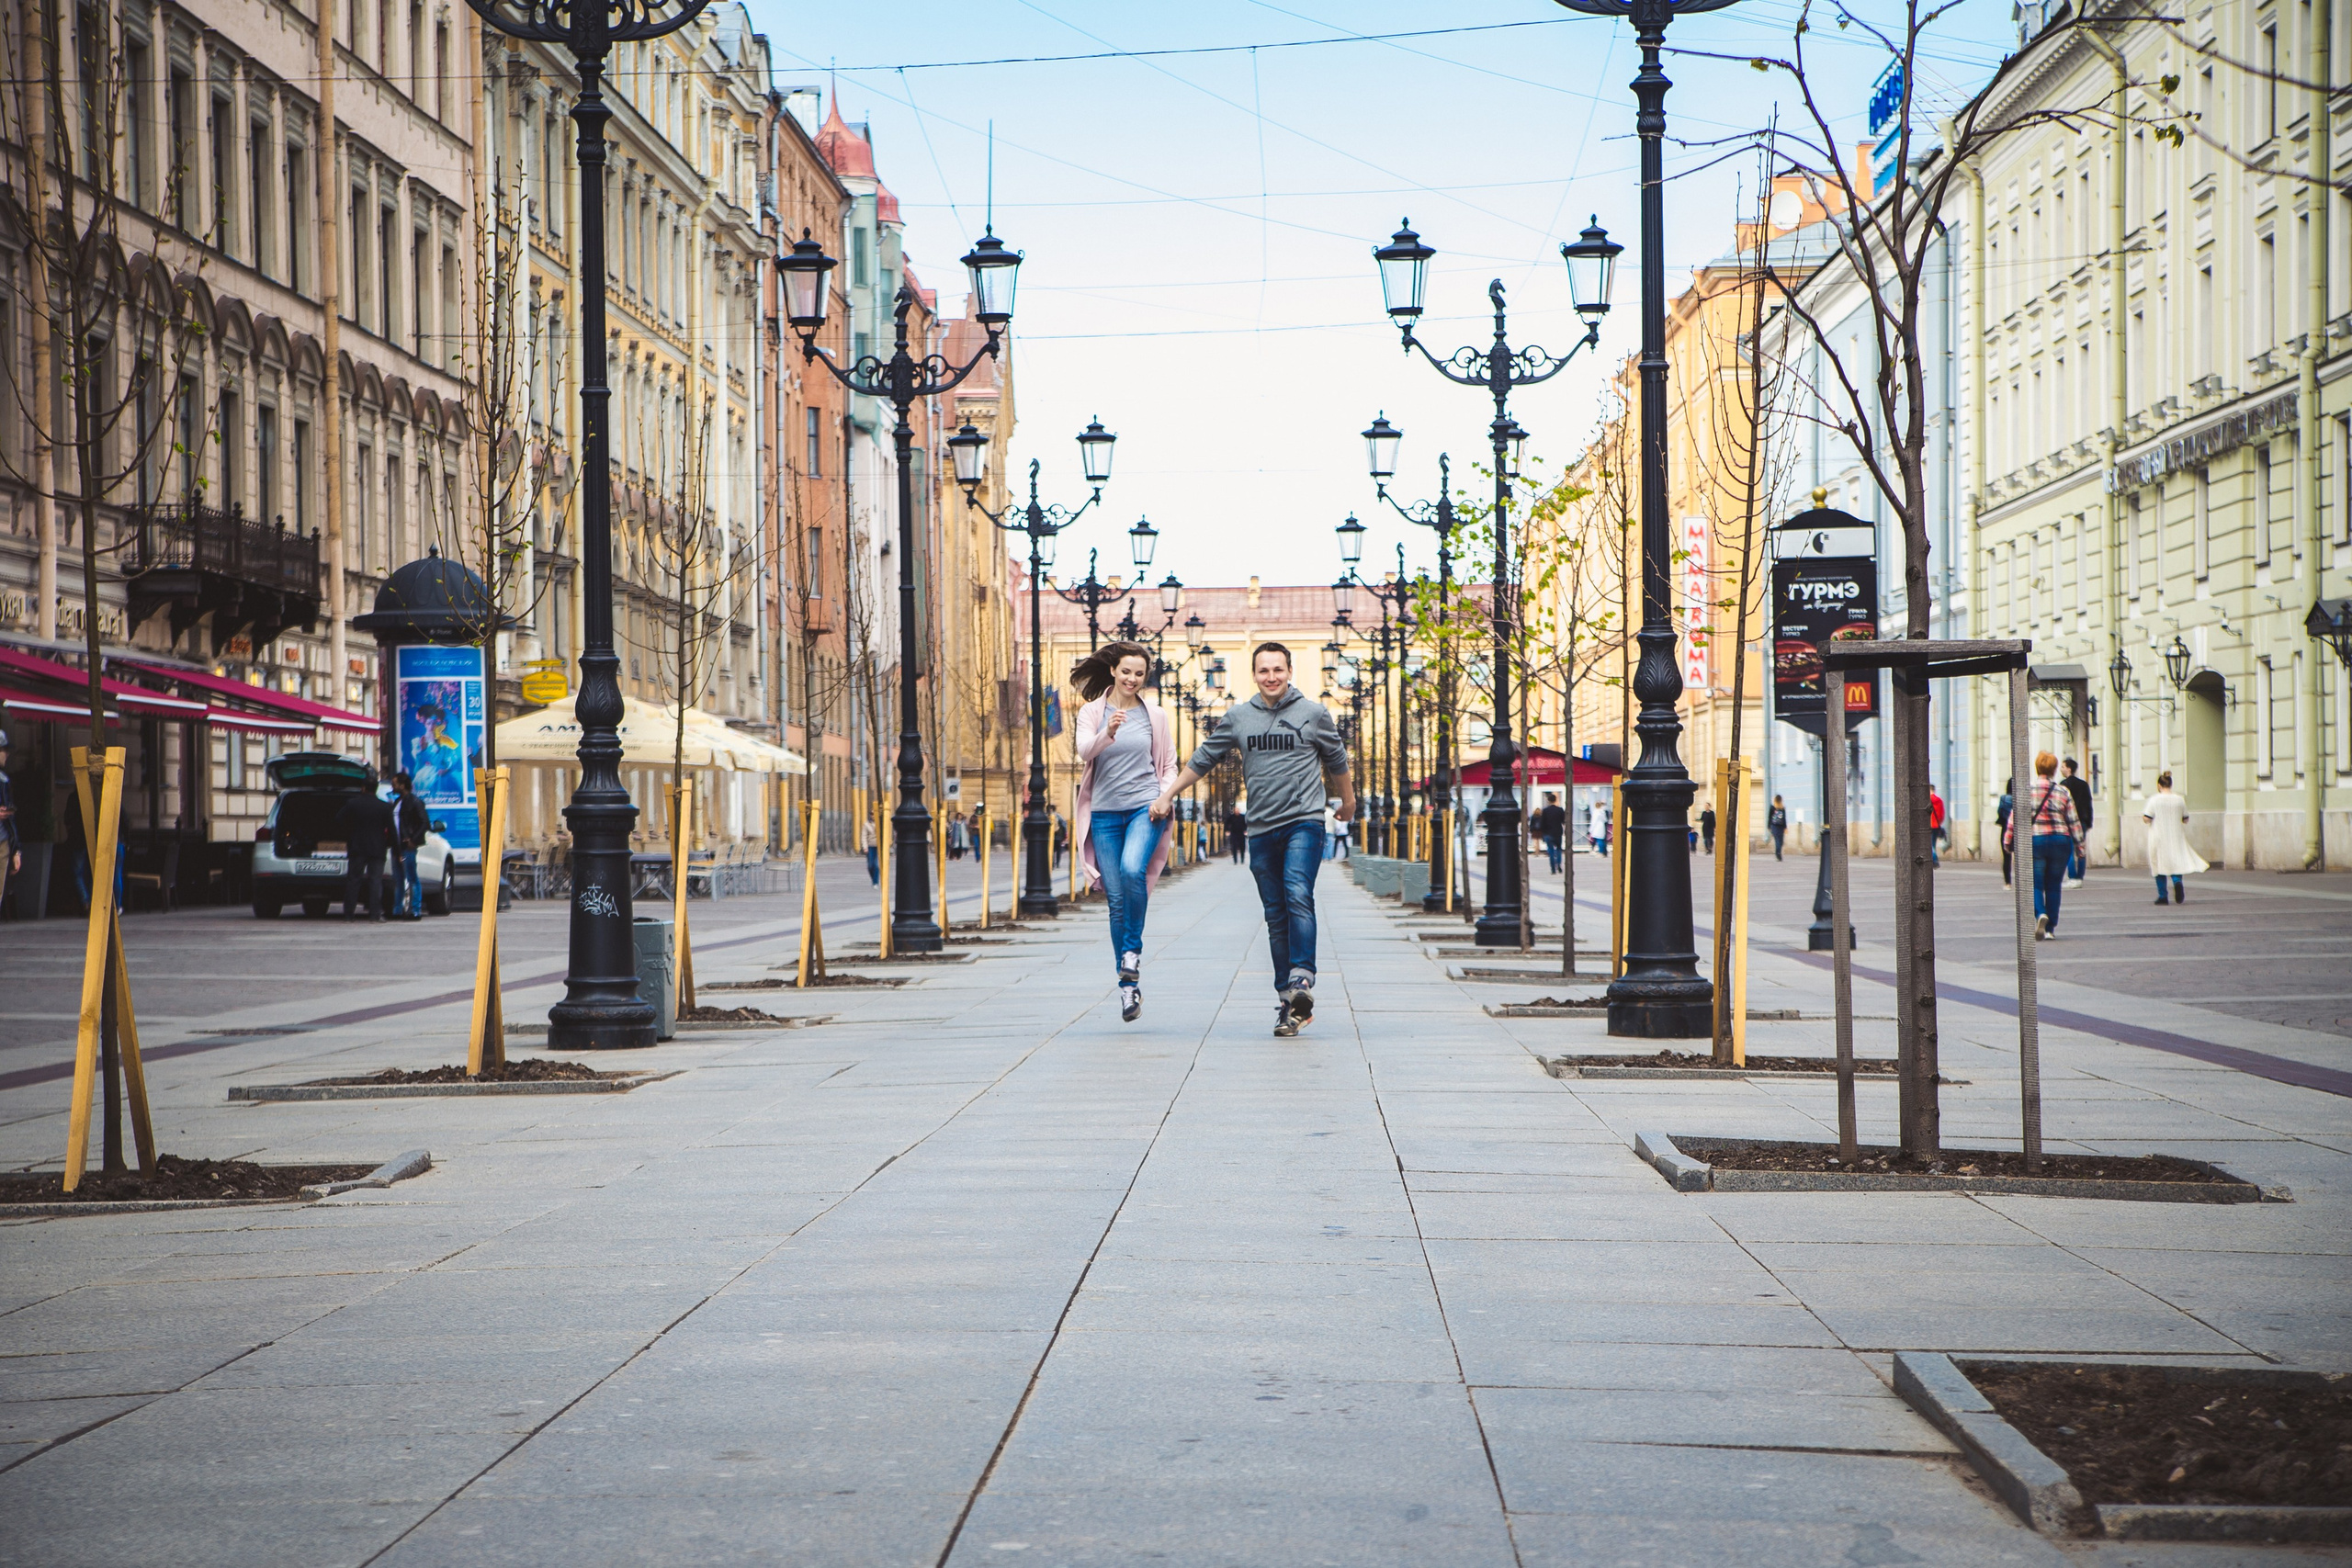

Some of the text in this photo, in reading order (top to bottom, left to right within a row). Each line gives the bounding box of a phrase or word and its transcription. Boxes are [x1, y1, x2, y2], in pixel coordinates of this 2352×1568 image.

[1788, 581, 1860, 601] ГУРМЭ
[469, 696, 481, 708] 30
[1247, 734, 1295, 751] PUMA
